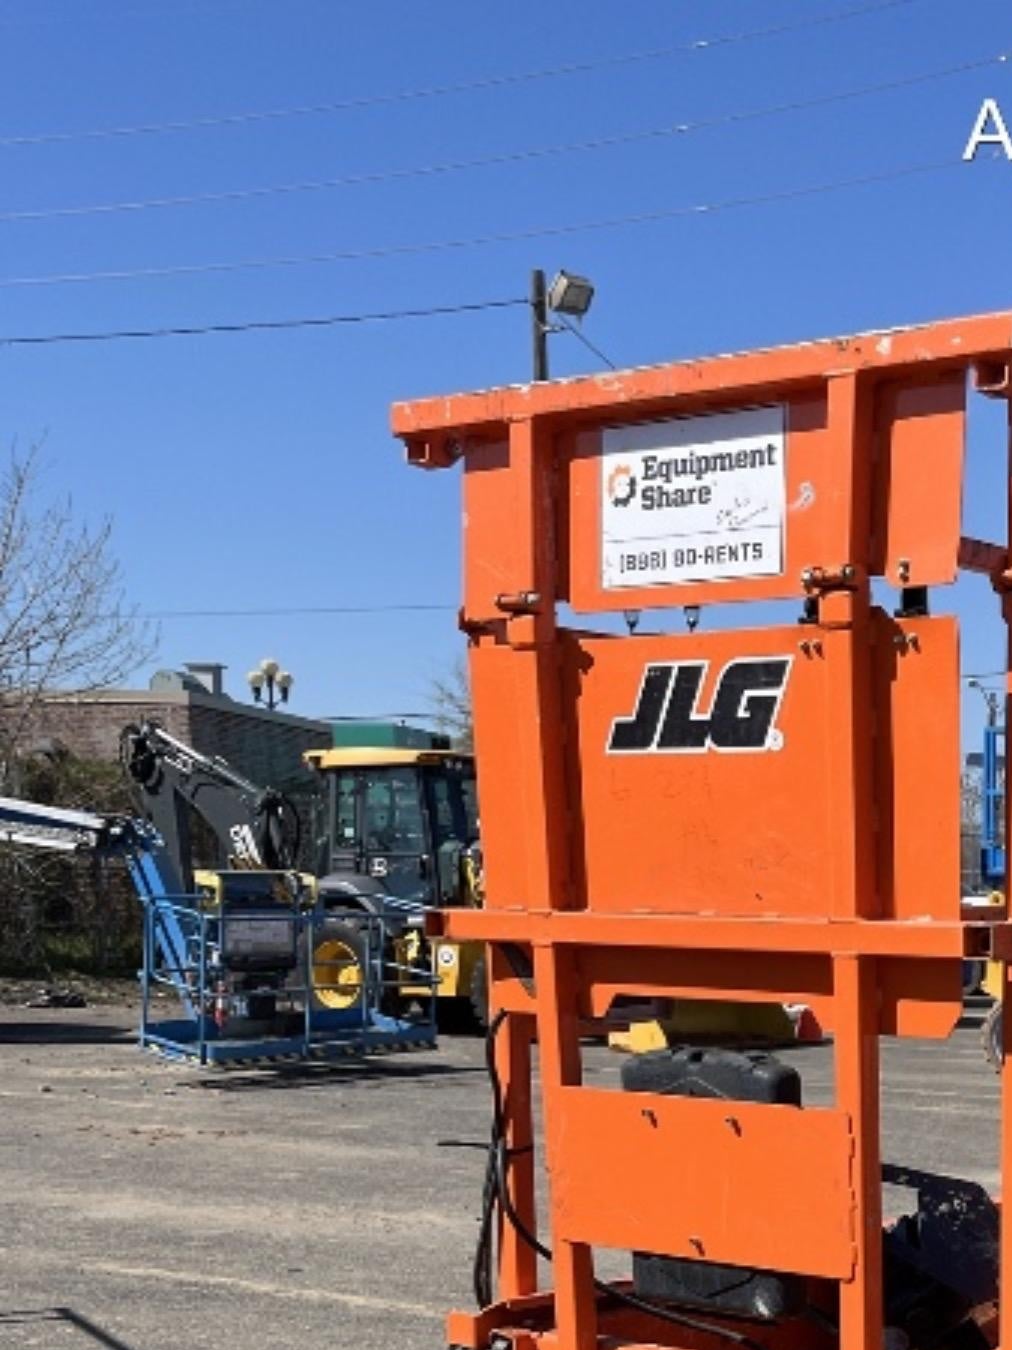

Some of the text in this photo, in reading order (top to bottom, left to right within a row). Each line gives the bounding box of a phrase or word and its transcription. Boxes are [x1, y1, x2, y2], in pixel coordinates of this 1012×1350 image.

[641, 444, 776, 483] Equipment
[641, 485, 712, 510] Share
[606, 655, 794, 754] JLG
